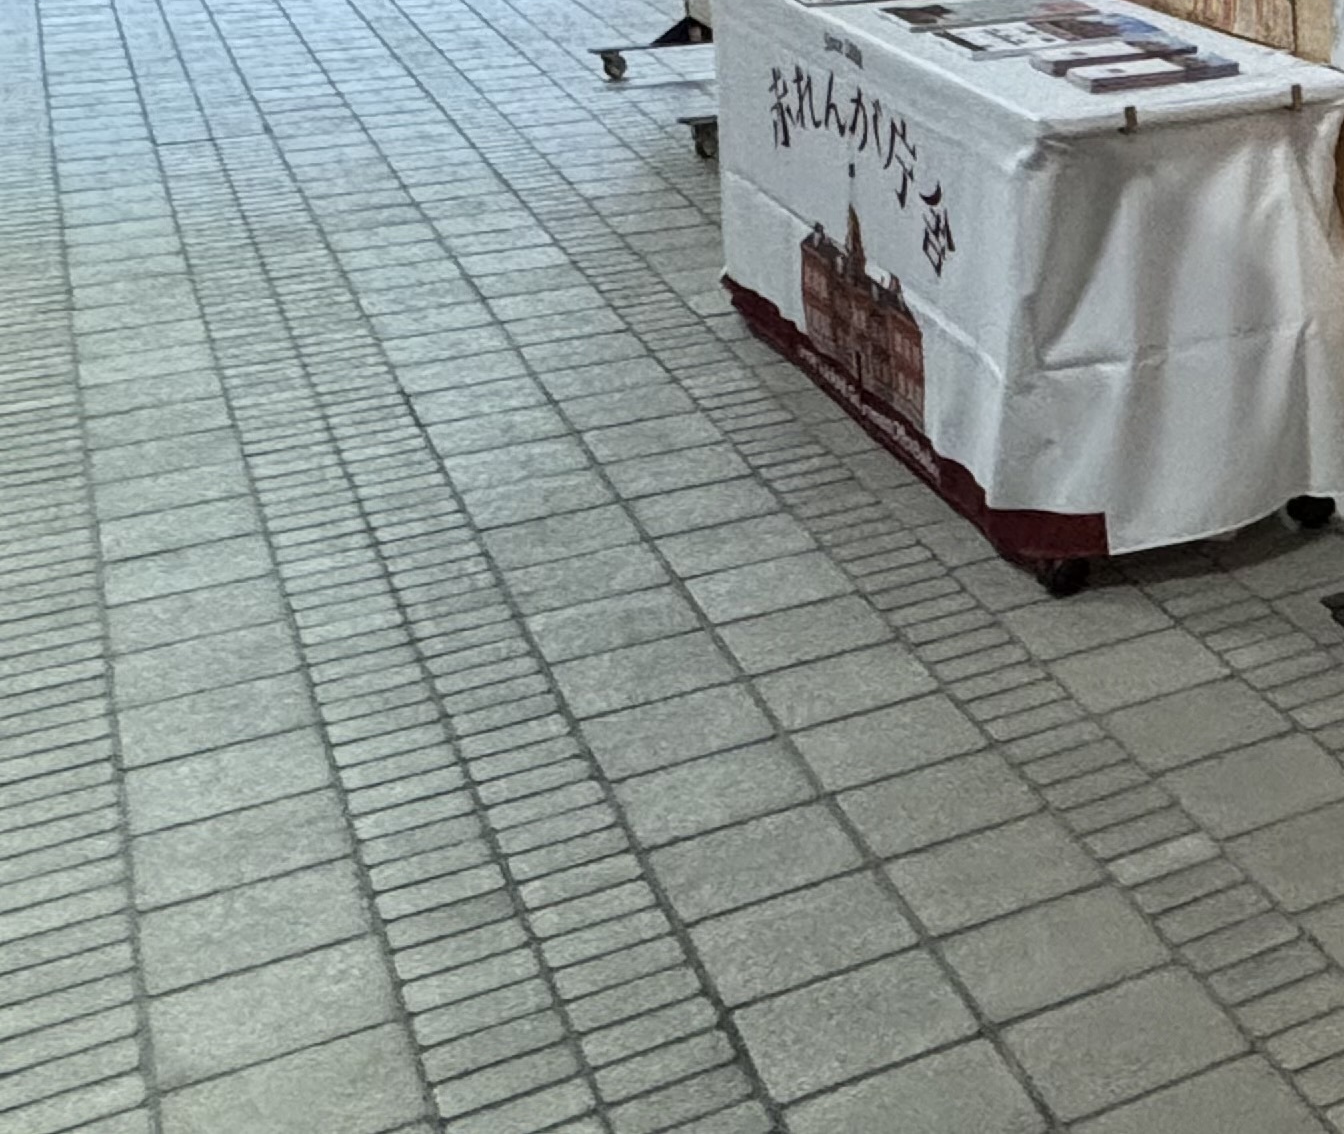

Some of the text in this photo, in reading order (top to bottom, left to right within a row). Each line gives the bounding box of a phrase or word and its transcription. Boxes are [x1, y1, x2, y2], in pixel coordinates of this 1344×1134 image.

[769, 64, 955, 277] 赤れんが庁舎
